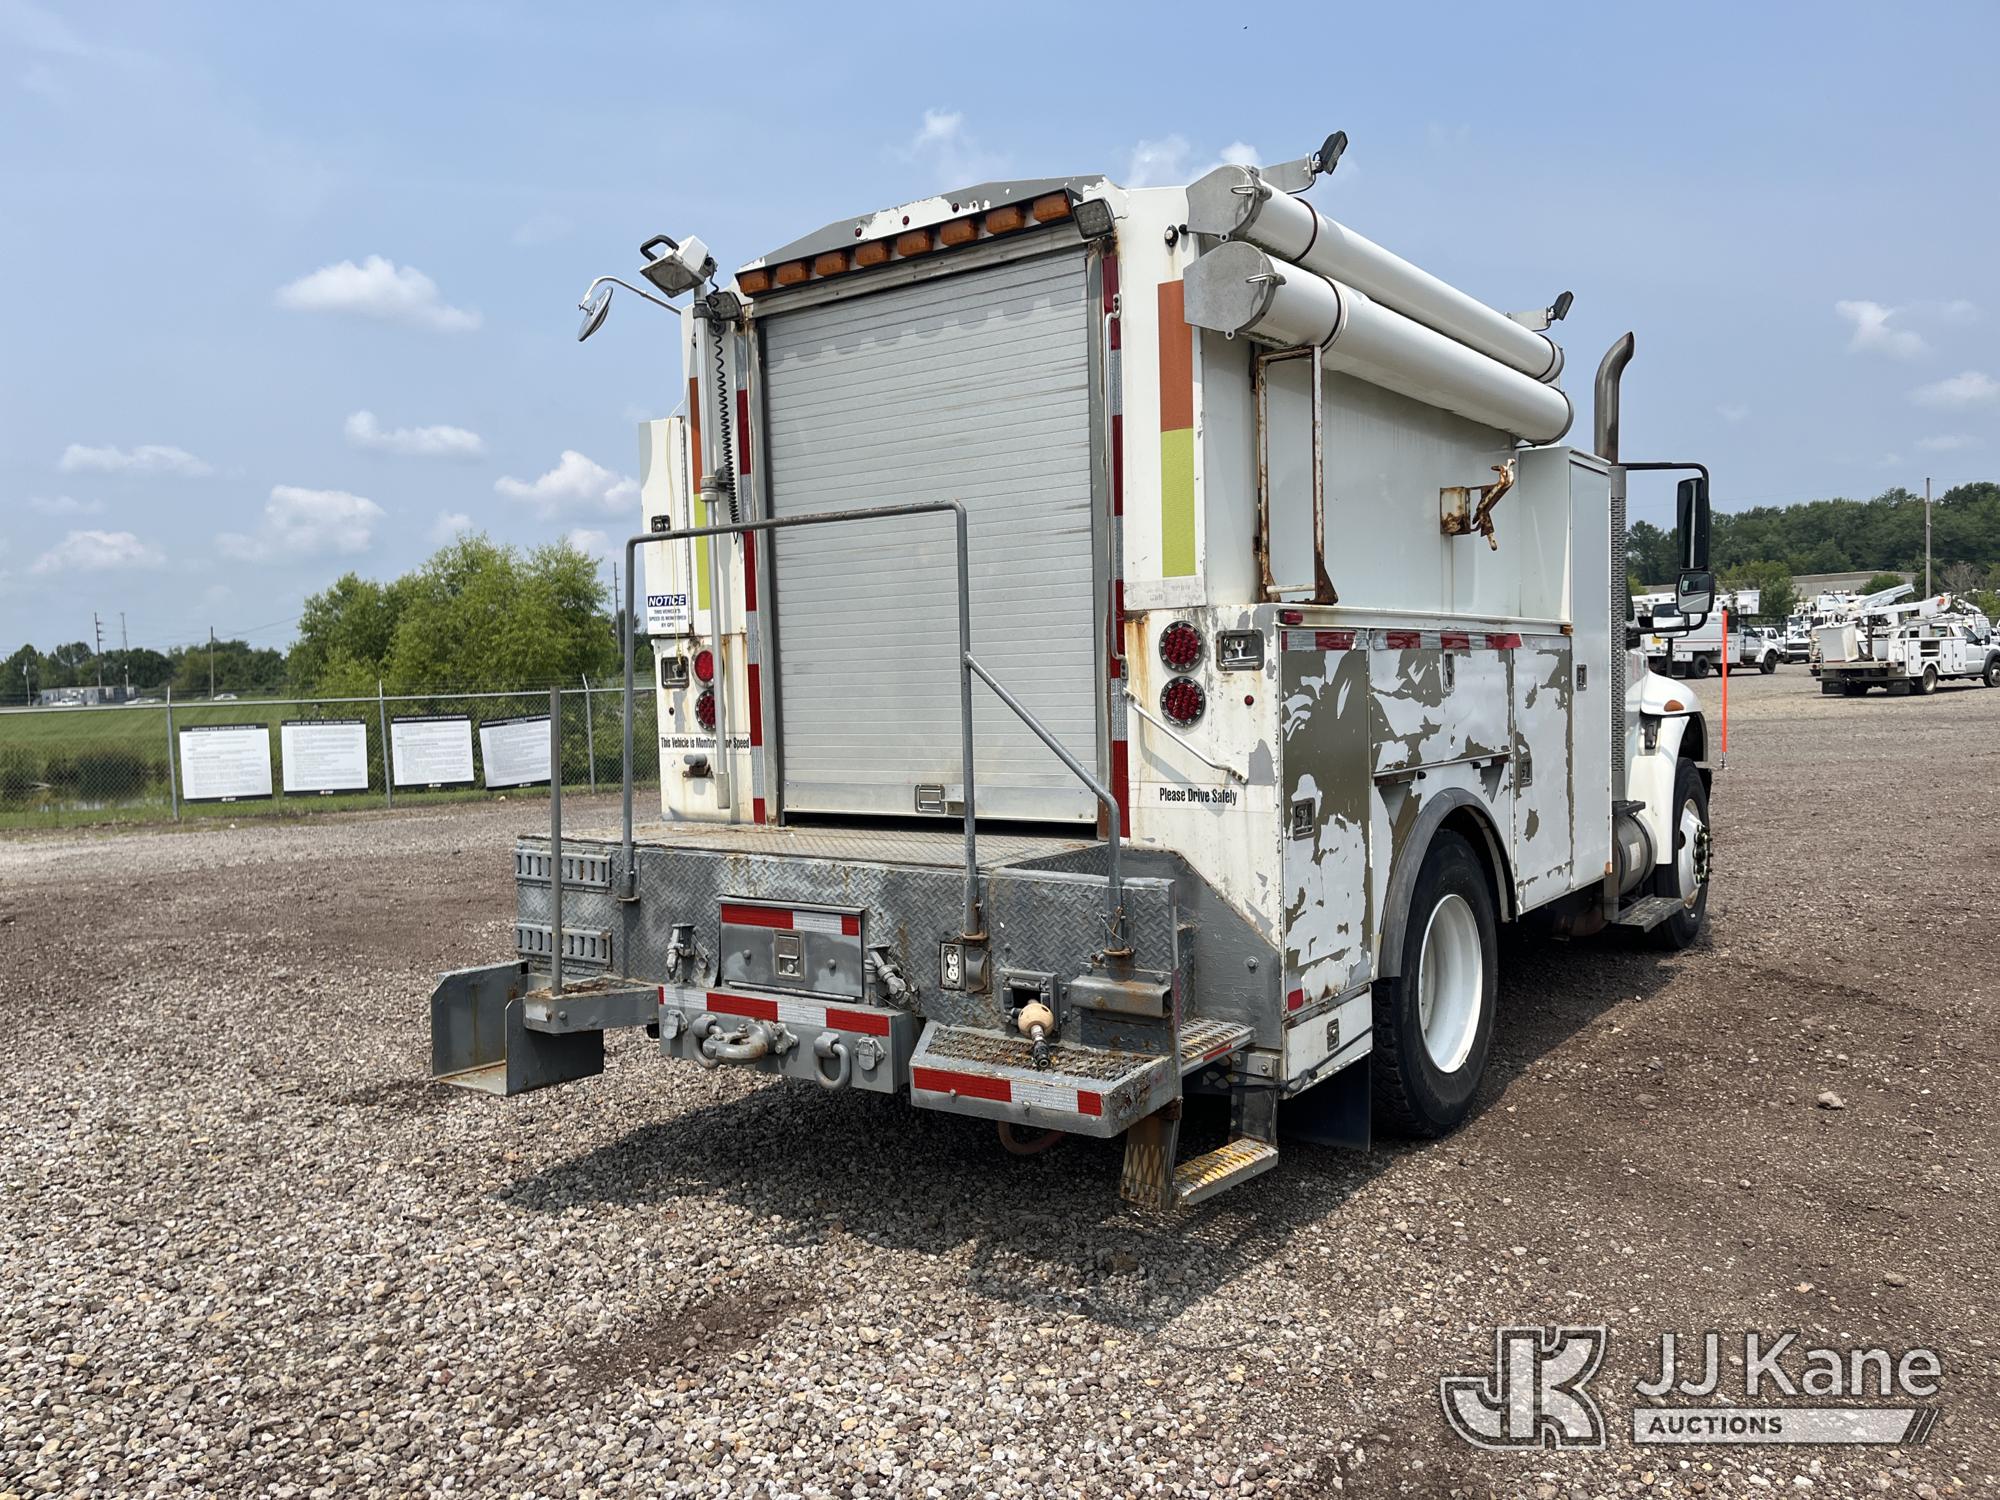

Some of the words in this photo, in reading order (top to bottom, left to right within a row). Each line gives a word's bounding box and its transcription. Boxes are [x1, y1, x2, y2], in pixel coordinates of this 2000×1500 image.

[649, 595, 685, 606] NOTICE
[661, 737, 671, 749] This
[672, 737, 689, 749] Vehicle
[690, 737, 695, 748] is
[696, 737, 722, 749] Monitor
[734, 737, 749, 749] Speed
[1160, 788, 1185, 801] Please
[1188, 788, 1210, 802] Drive
[1212, 789, 1237, 806] Safely
